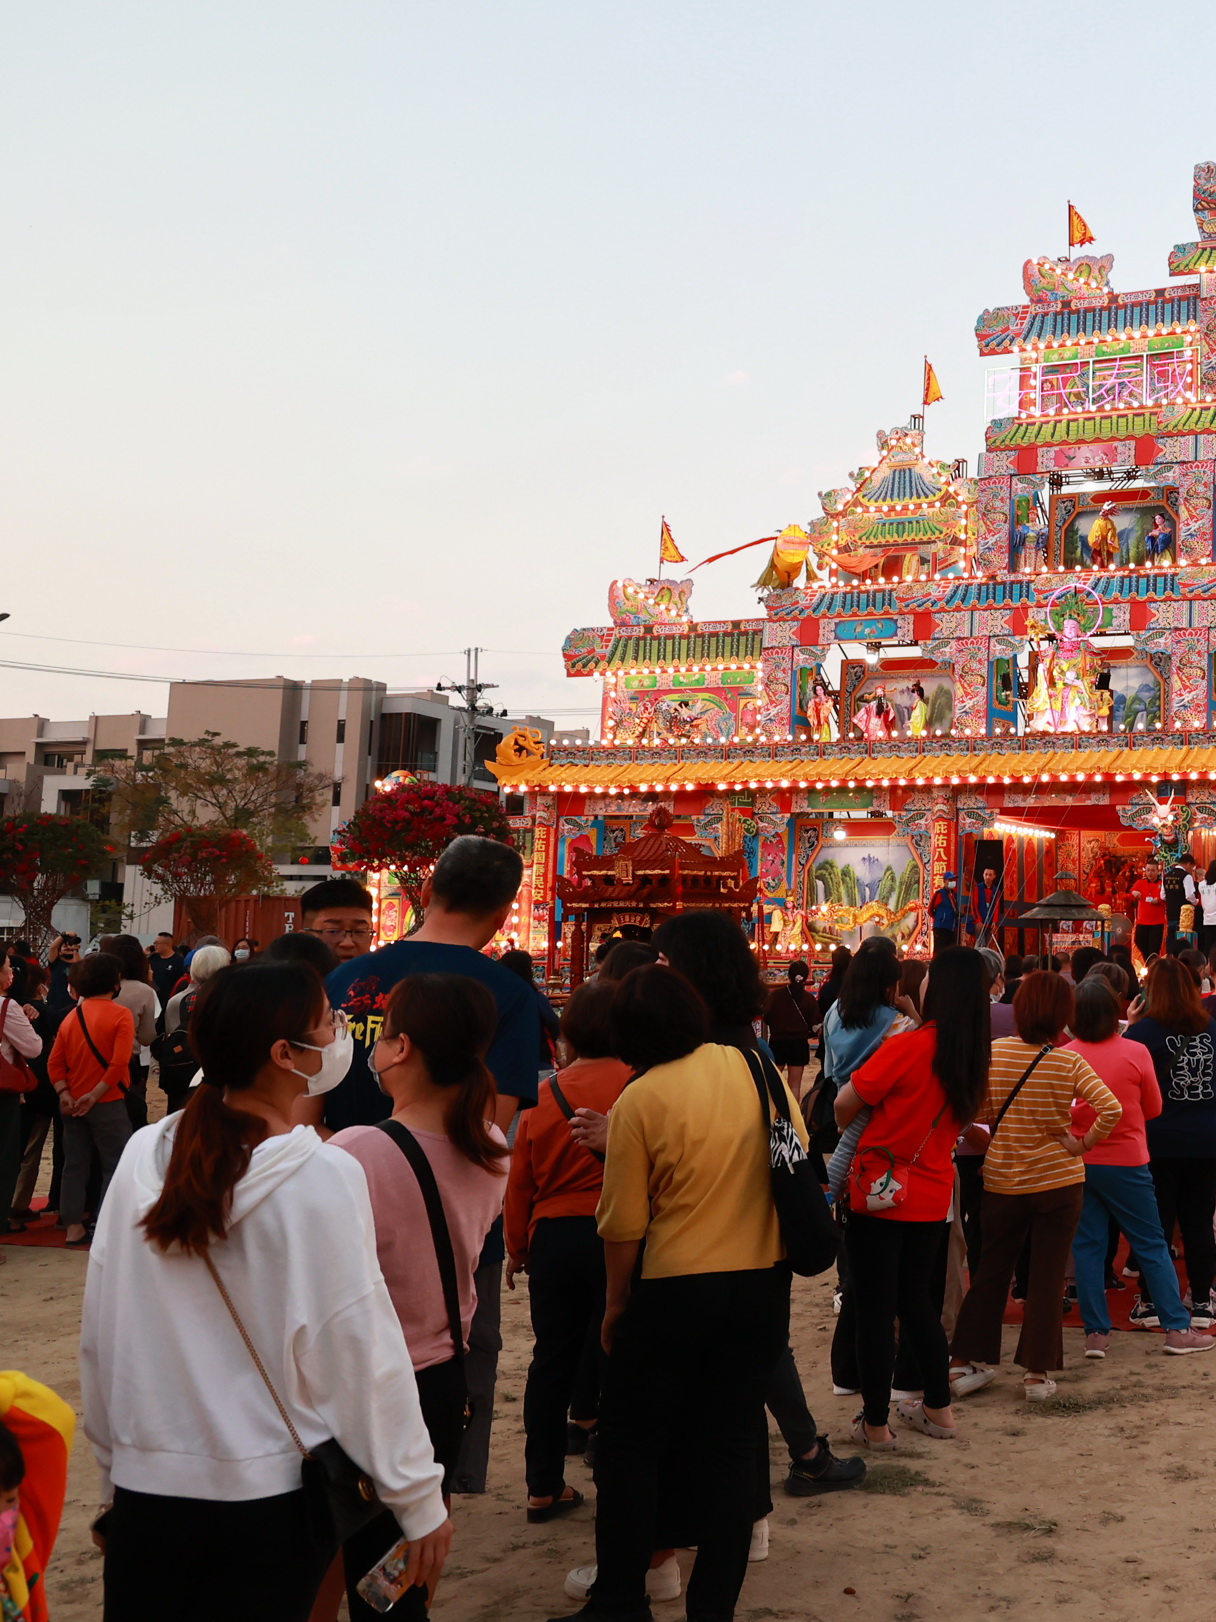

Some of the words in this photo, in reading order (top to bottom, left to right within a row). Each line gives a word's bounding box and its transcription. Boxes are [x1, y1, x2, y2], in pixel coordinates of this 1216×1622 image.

[933, 820, 948, 894] 庇佑八節有
